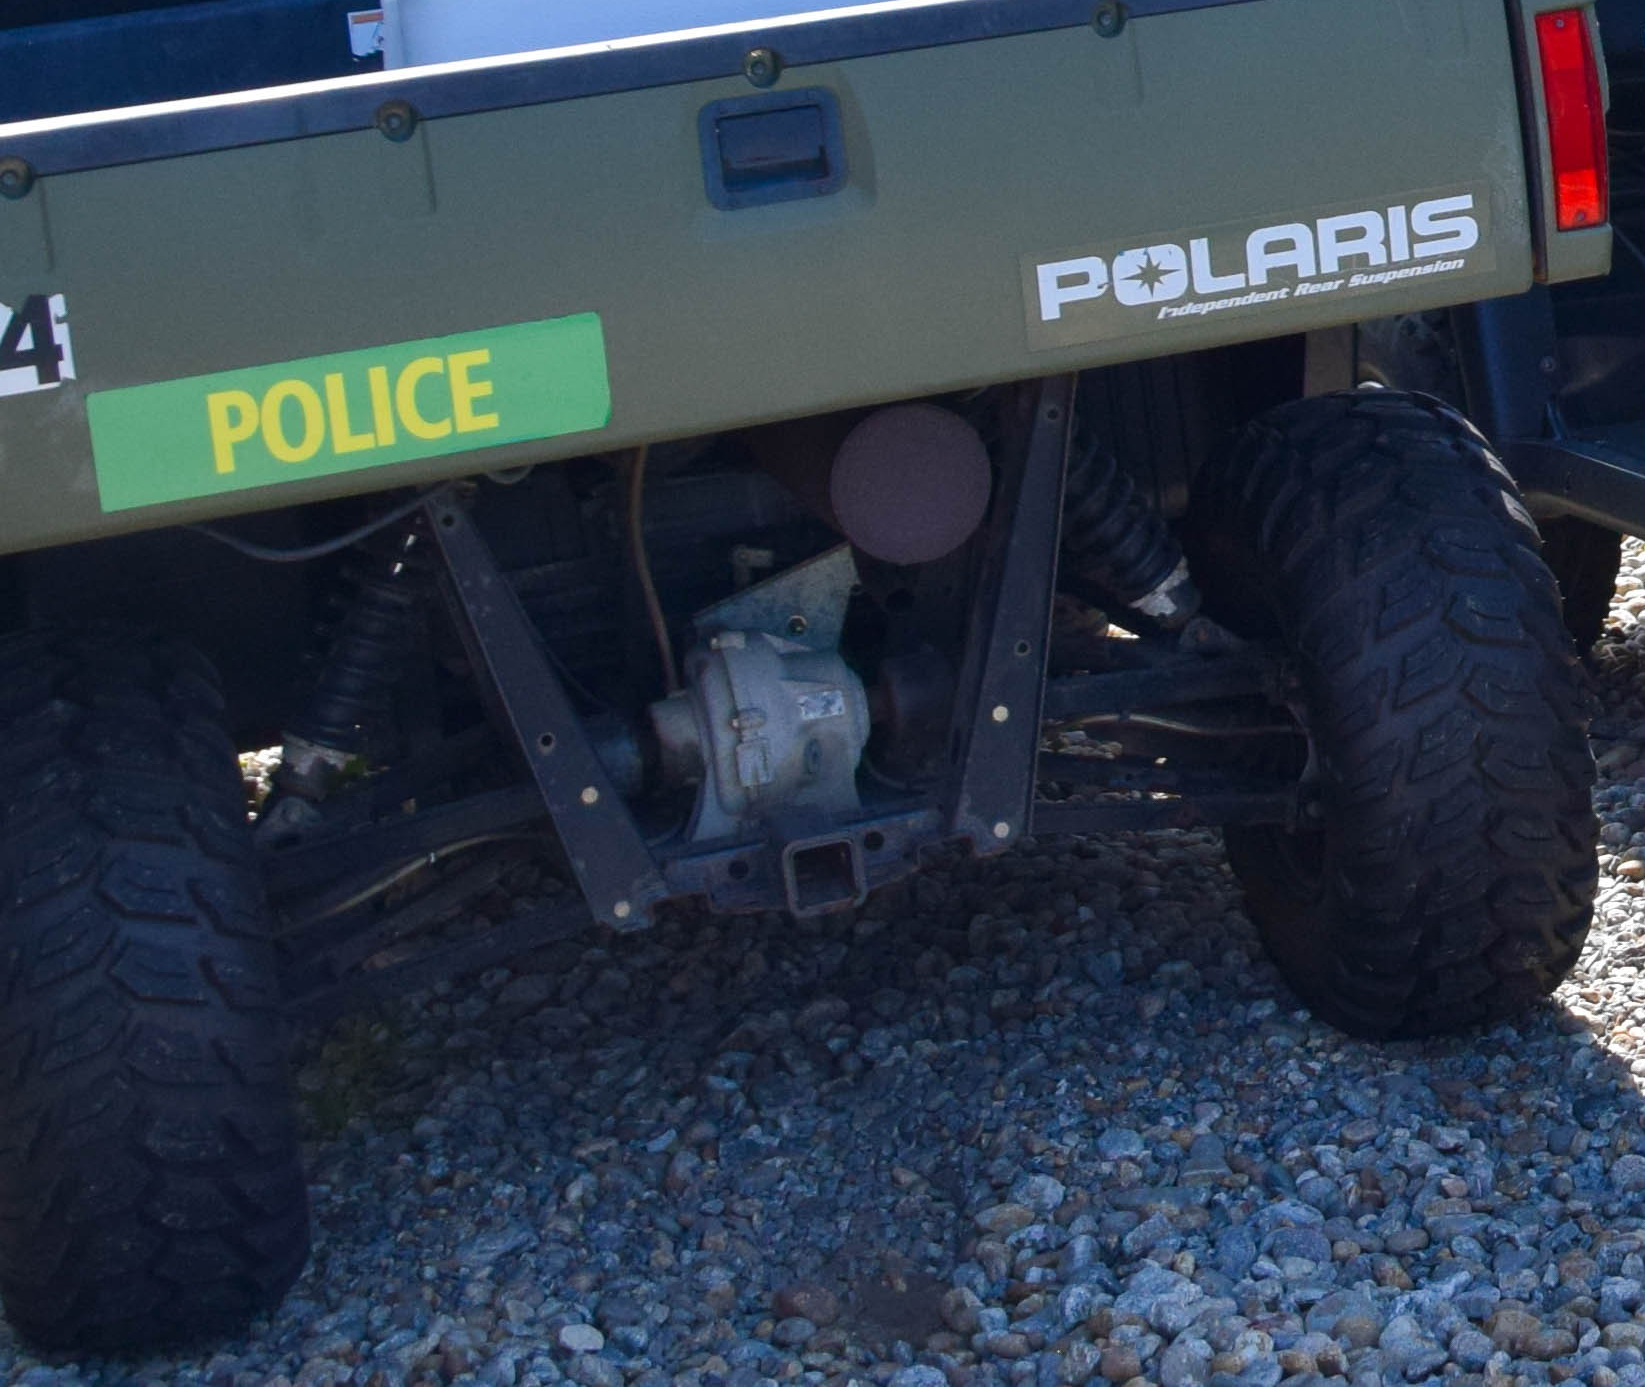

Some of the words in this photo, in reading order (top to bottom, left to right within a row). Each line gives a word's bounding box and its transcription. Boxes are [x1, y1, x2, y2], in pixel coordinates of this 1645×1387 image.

[1036, 194, 1480, 322] POLARIS
[1157, 286, 1291, 320] Independent
[1294, 279, 1345, 298] Rear
[1347, 258, 1466, 288] Suspension
[206, 348, 500, 475] POLICE
